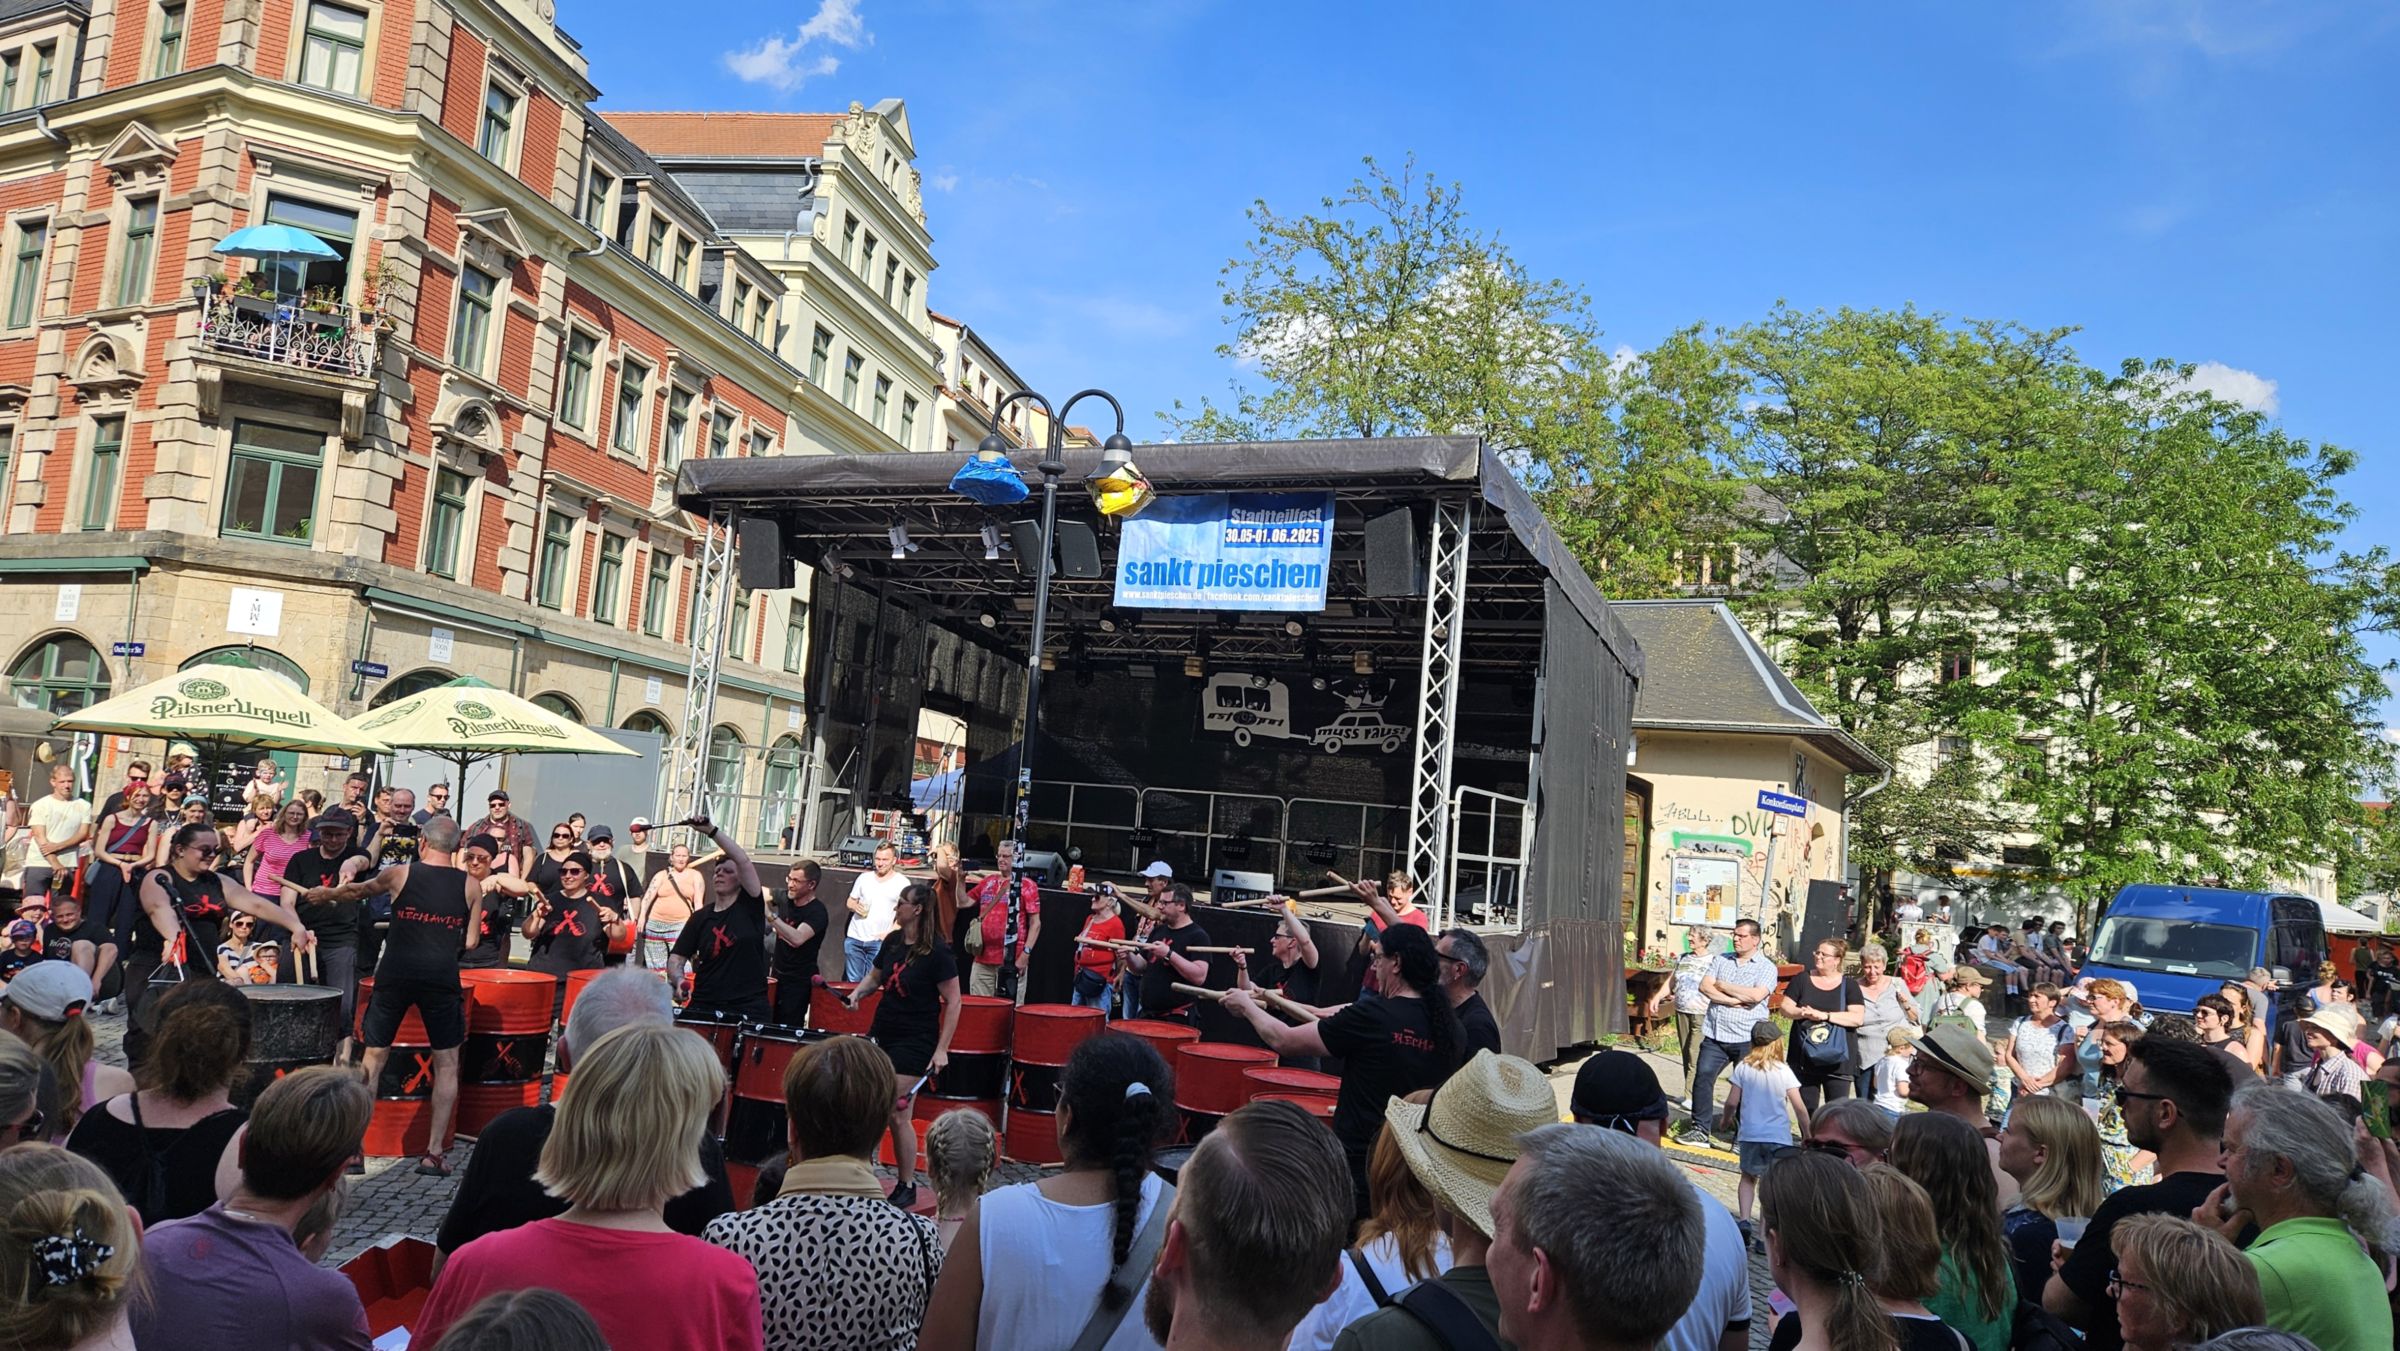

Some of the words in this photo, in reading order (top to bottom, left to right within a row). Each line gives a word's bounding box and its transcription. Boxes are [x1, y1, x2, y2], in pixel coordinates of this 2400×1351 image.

[1231, 507, 1322, 525] Stadtteilfest
[1124, 557, 1193, 587] sankt
[1197, 558, 1322, 590] pieschen
[150, 695, 236, 720] Pilsner
[234, 698, 312, 725] Urquell
[446, 717, 509, 739] Pilsner
[505, 716, 566, 739] Urquell
[1317, 727, 1360, 739] muss
[1364, 727, 1406, 740] raus!
[1761, 794, 1806, 813] Konkordienplatz
